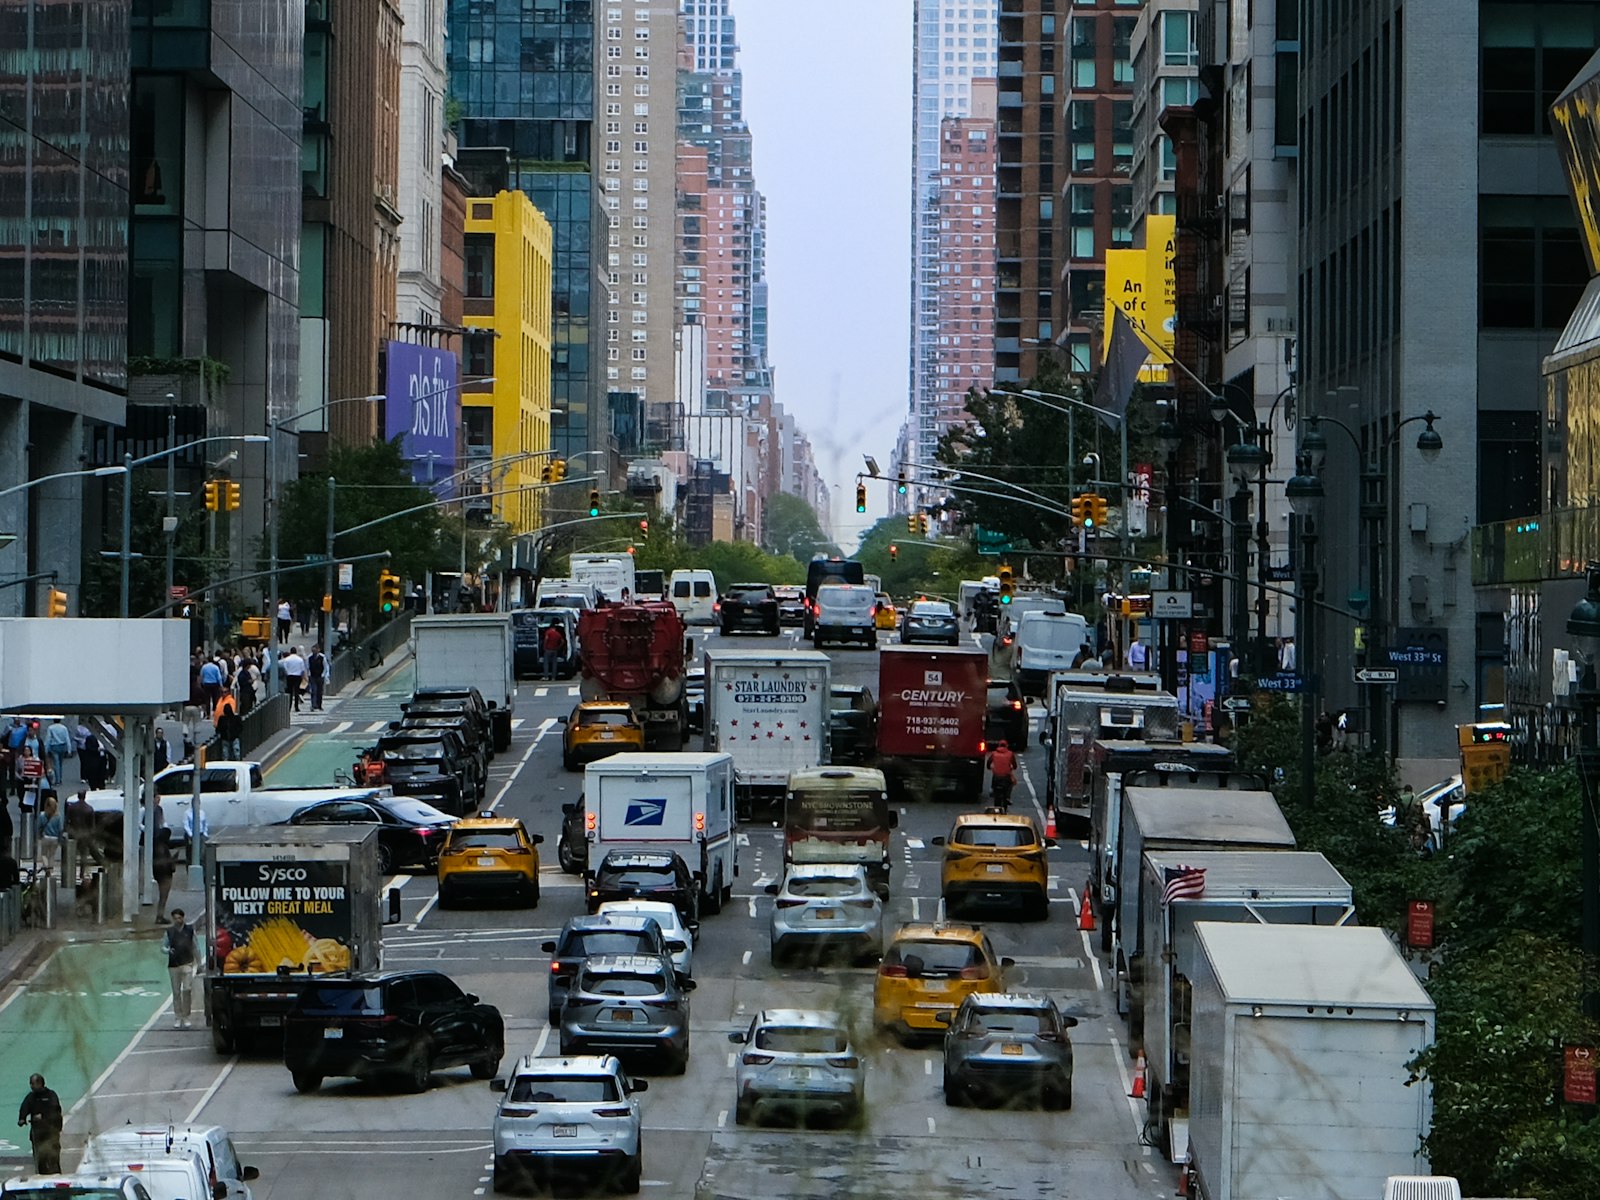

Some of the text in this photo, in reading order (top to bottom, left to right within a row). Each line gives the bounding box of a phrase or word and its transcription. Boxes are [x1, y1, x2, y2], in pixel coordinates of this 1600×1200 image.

[1123, 279, 1142, 293] An
[1123, 297, 1138, 311] of
[432, 356, 449, 438] fix
[1388, 651, 1442, 663] West 33rd St
[928, 674, 939, 682] 54
[1257, 678, 1282, 688] West
[735, 681, 808, 693] STAR LAUNDRY
[901, 689, 965, 702] CENTURY
[258, 865, 307, 884] Sysco
[222, 887, 345, 901] FOLLOW ME TO YOUR
[233, 901, 334, 914] NEXT GREAT MEAL
